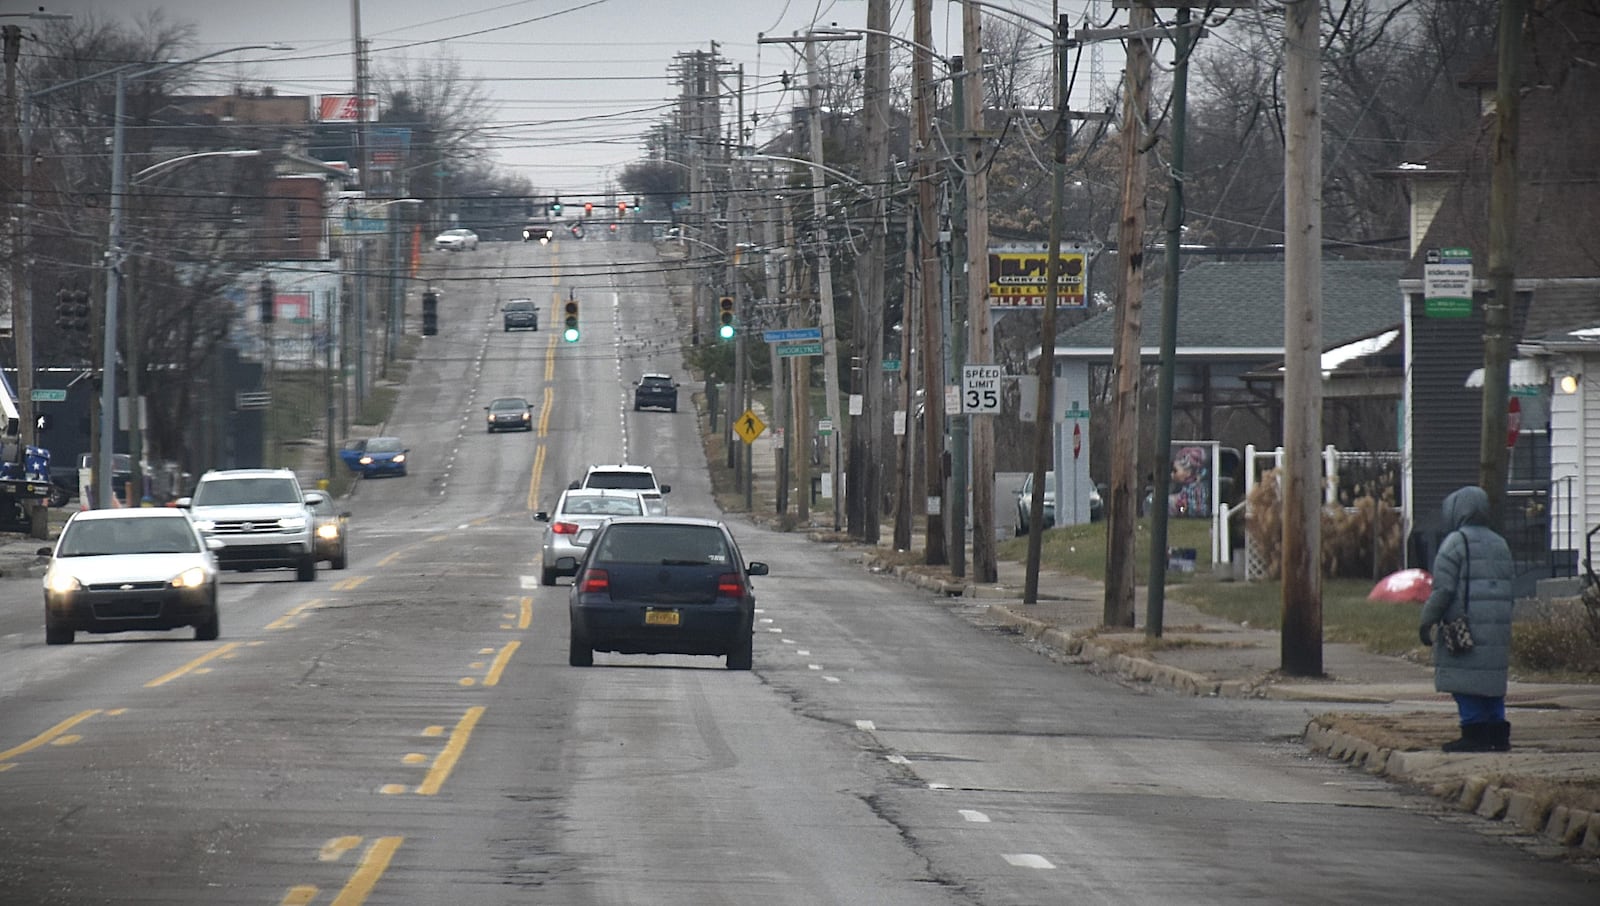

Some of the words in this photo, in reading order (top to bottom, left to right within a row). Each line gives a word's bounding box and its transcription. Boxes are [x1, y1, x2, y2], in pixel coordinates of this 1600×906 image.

[989, 286, 1021, 294] EER
[1037, 286, 1080, 294] WNE
[989, 296, 1013, 306] ELI
[1032, 296, 1081, 306] GILL
[777, 344, 814, 356] BROOKLYN
[965, 369, 999, 378] SPEED
[969, 380, 994, 389] LIMIT
[967, 390, 998, 409] 35
